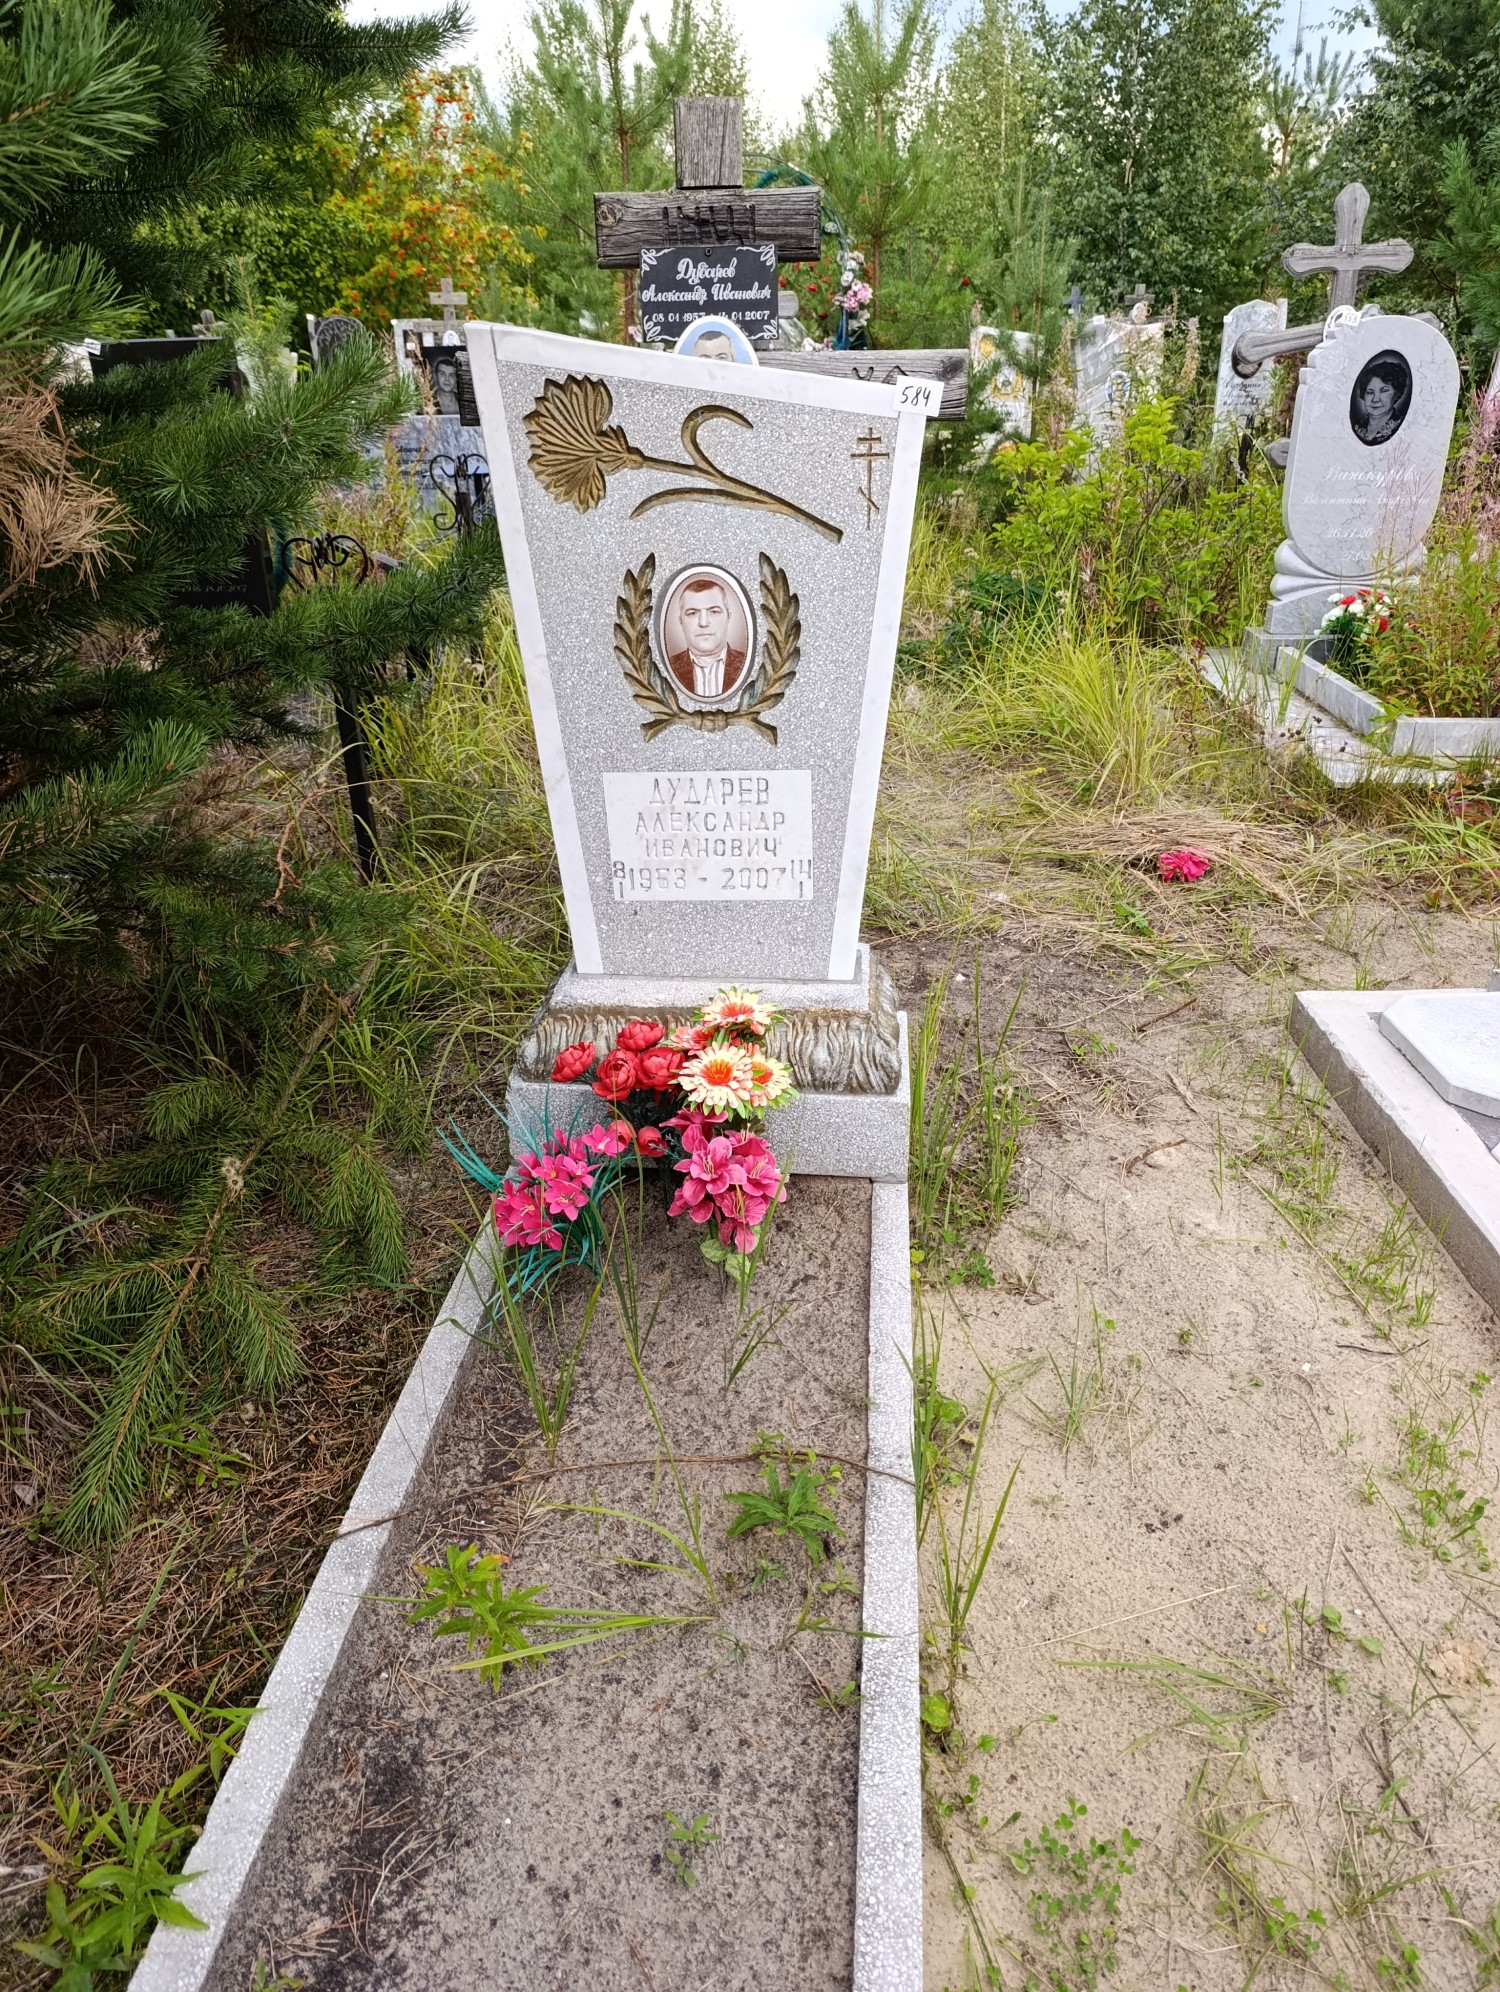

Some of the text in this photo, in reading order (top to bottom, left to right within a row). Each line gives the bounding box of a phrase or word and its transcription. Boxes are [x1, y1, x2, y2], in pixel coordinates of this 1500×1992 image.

[676, 257, 737, 285] Дударев
[642, 281, 771, 305] Александр Иванович
[900, 385, 931, 407] 584
[649, 777, 769, 806] ДУДАРЕВ
[635, 812, 785, 835] АЛЕКСАНДР
[645, 838, 778, 858] ИВАНОВИЧ
[629, 868, 687, 891] 1953
[721, 867, 787, 890] 2007
